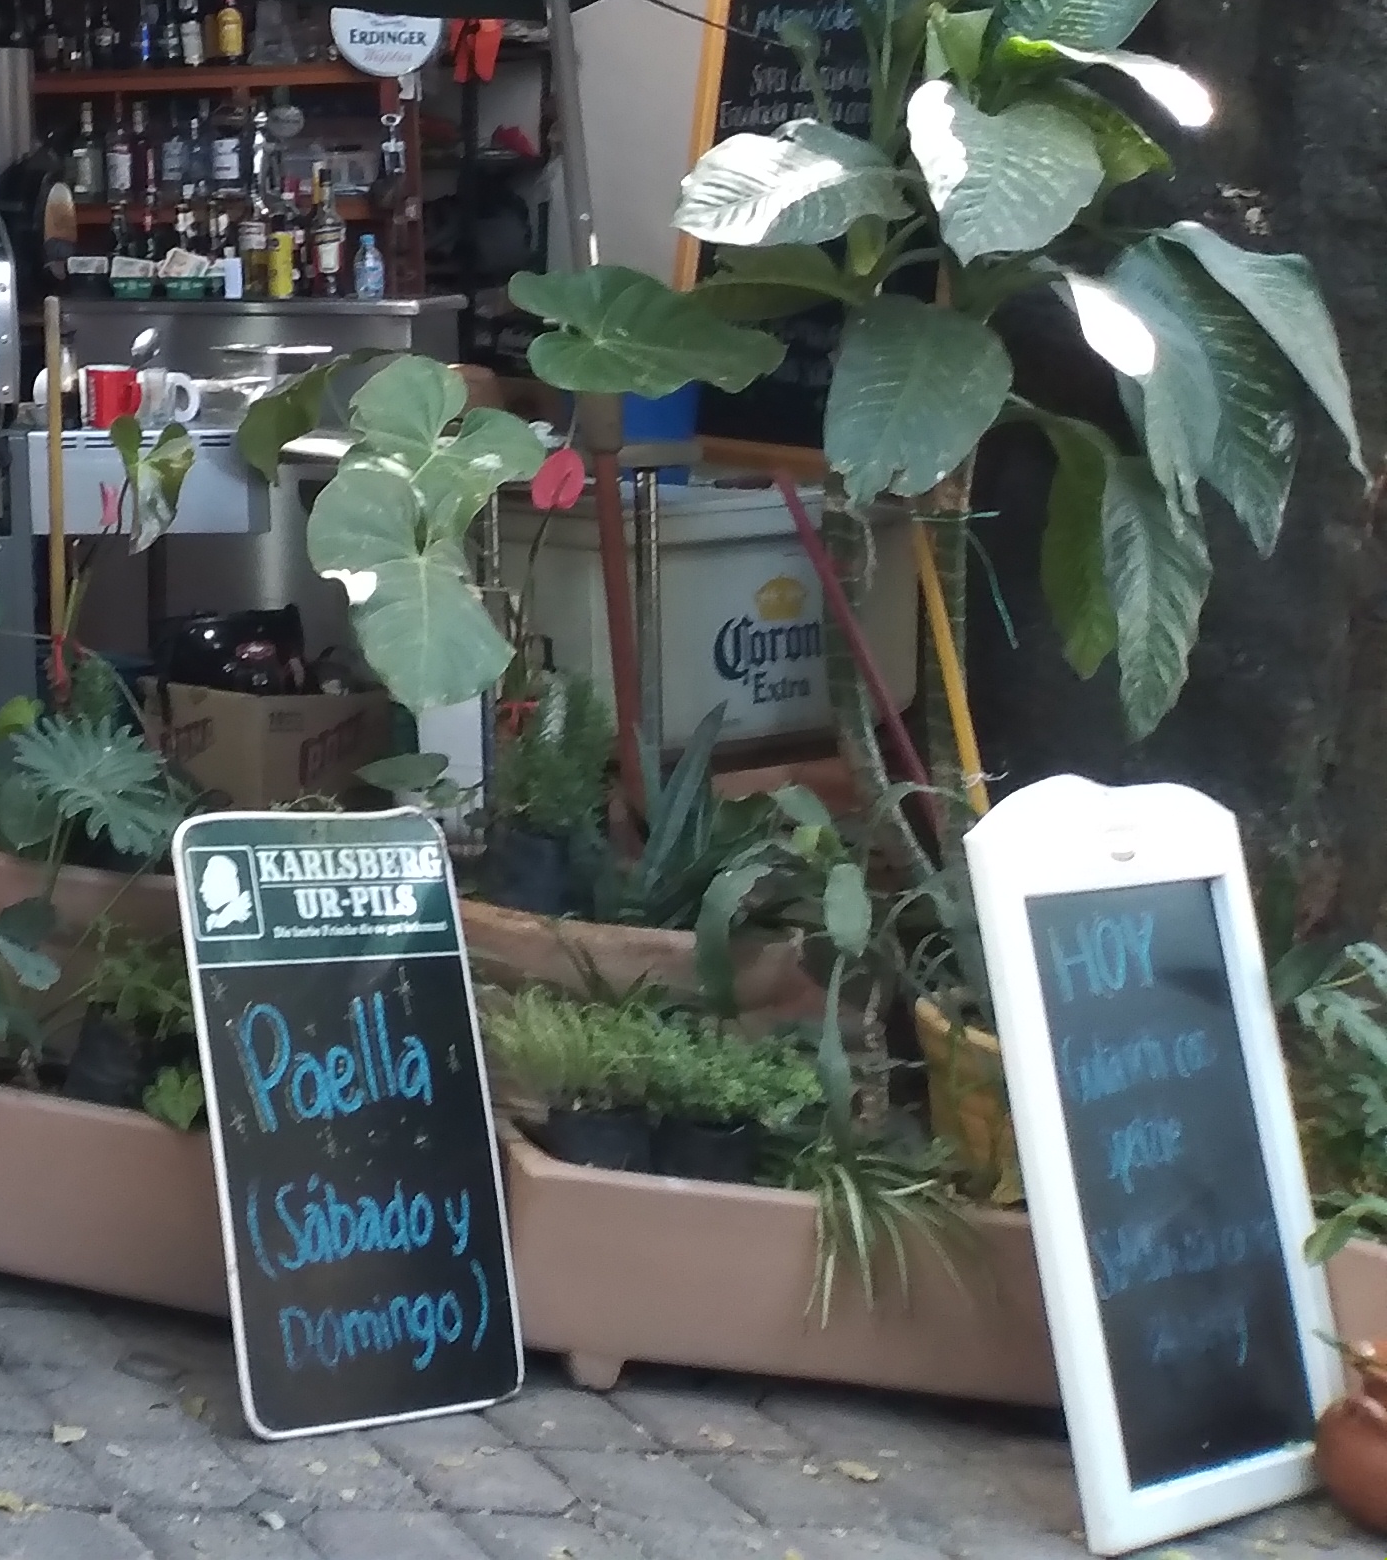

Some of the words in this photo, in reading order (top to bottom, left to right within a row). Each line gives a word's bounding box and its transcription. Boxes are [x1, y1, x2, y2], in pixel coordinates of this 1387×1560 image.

[349, 28, 427, 46] ERDINGER
[713, 615, 821, 681] Coron
[752, 671, 811, 705] Extra
[255, 846, 444, 883] KARLSBERG
[293, 884, 418, 920] UR-PILS
[1047, 911, 1155, 1003] HOY
[237, 991, 433, 1133] Paella
[444, 1188, 471, 1257] y
